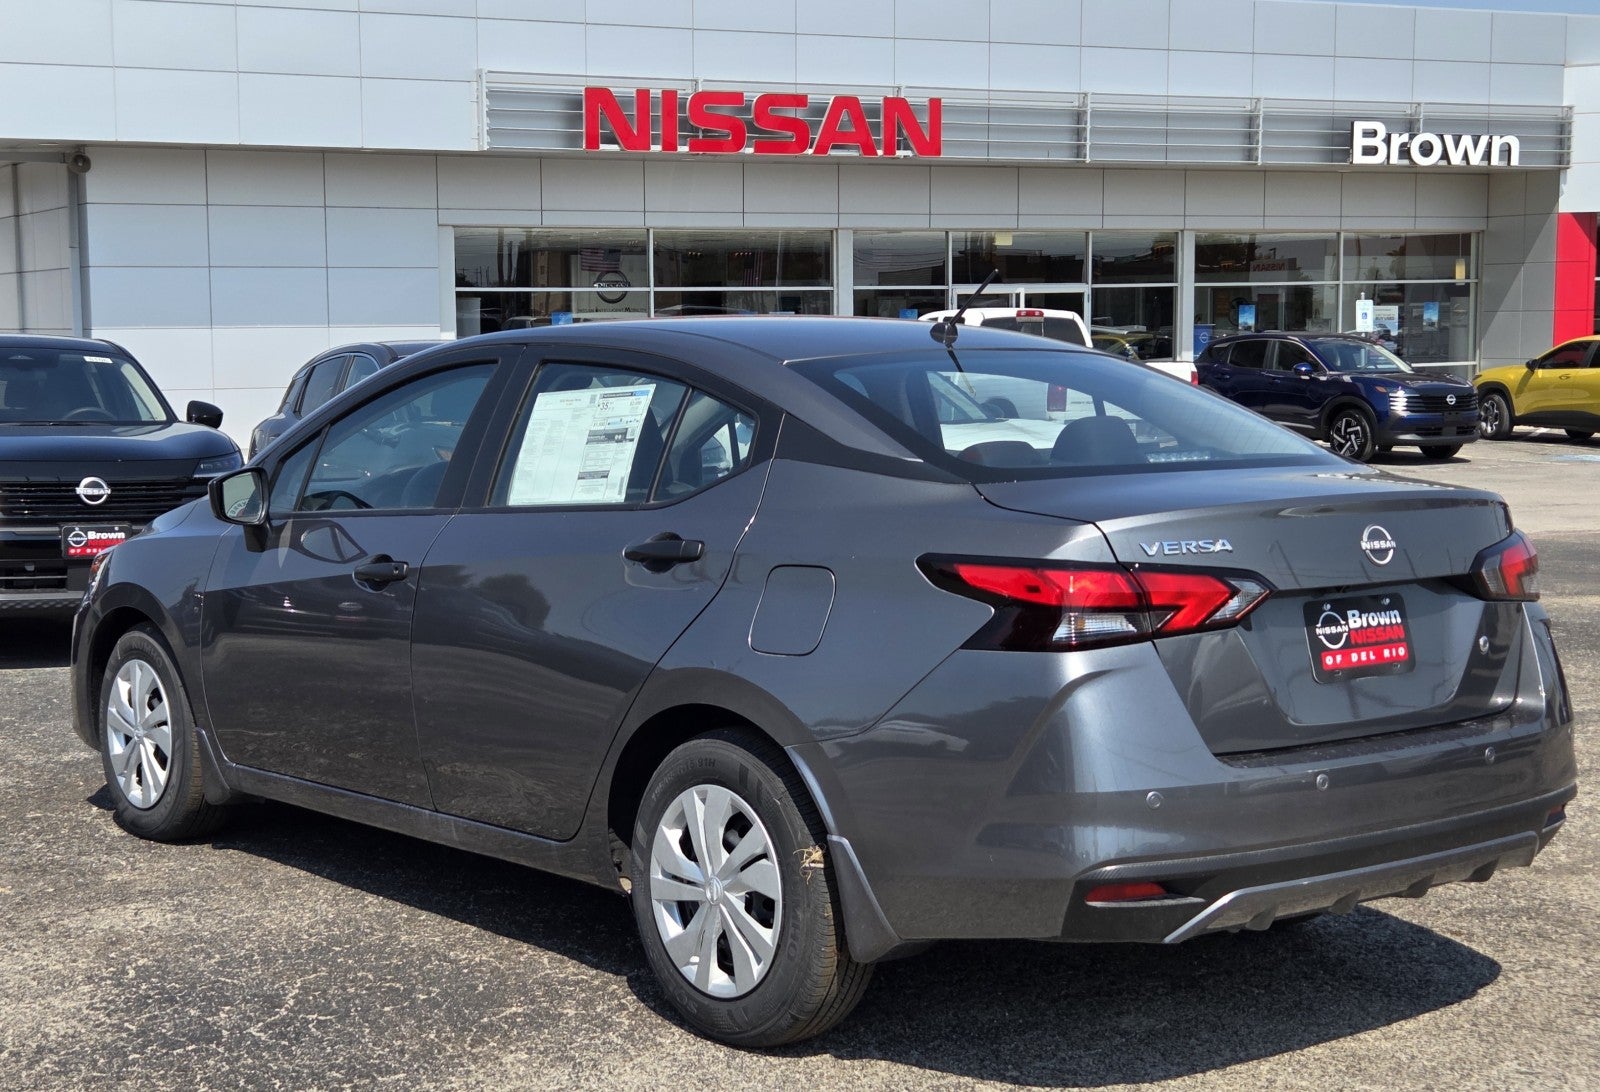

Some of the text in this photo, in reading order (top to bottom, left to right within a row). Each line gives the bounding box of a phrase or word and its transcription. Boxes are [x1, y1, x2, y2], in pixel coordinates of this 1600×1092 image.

[583, 87, 942, 158] NISSAN
[1351, 121, 1520, 166] Brown
[76, 487, 112, 495] NISSAN
[87, 531, 125, 540] Brown
[1139, 539, 1233, 556] VERSA
[1360, 540, 1396, 550] NISSAN
[1346, 609, 1402, 629] Brown
[1315, 625, 1349, 635] NISSAN
[1349, 624, 1405, 645] NISSAN
[1325, 647, 1405, 665] OF DEL RIO
